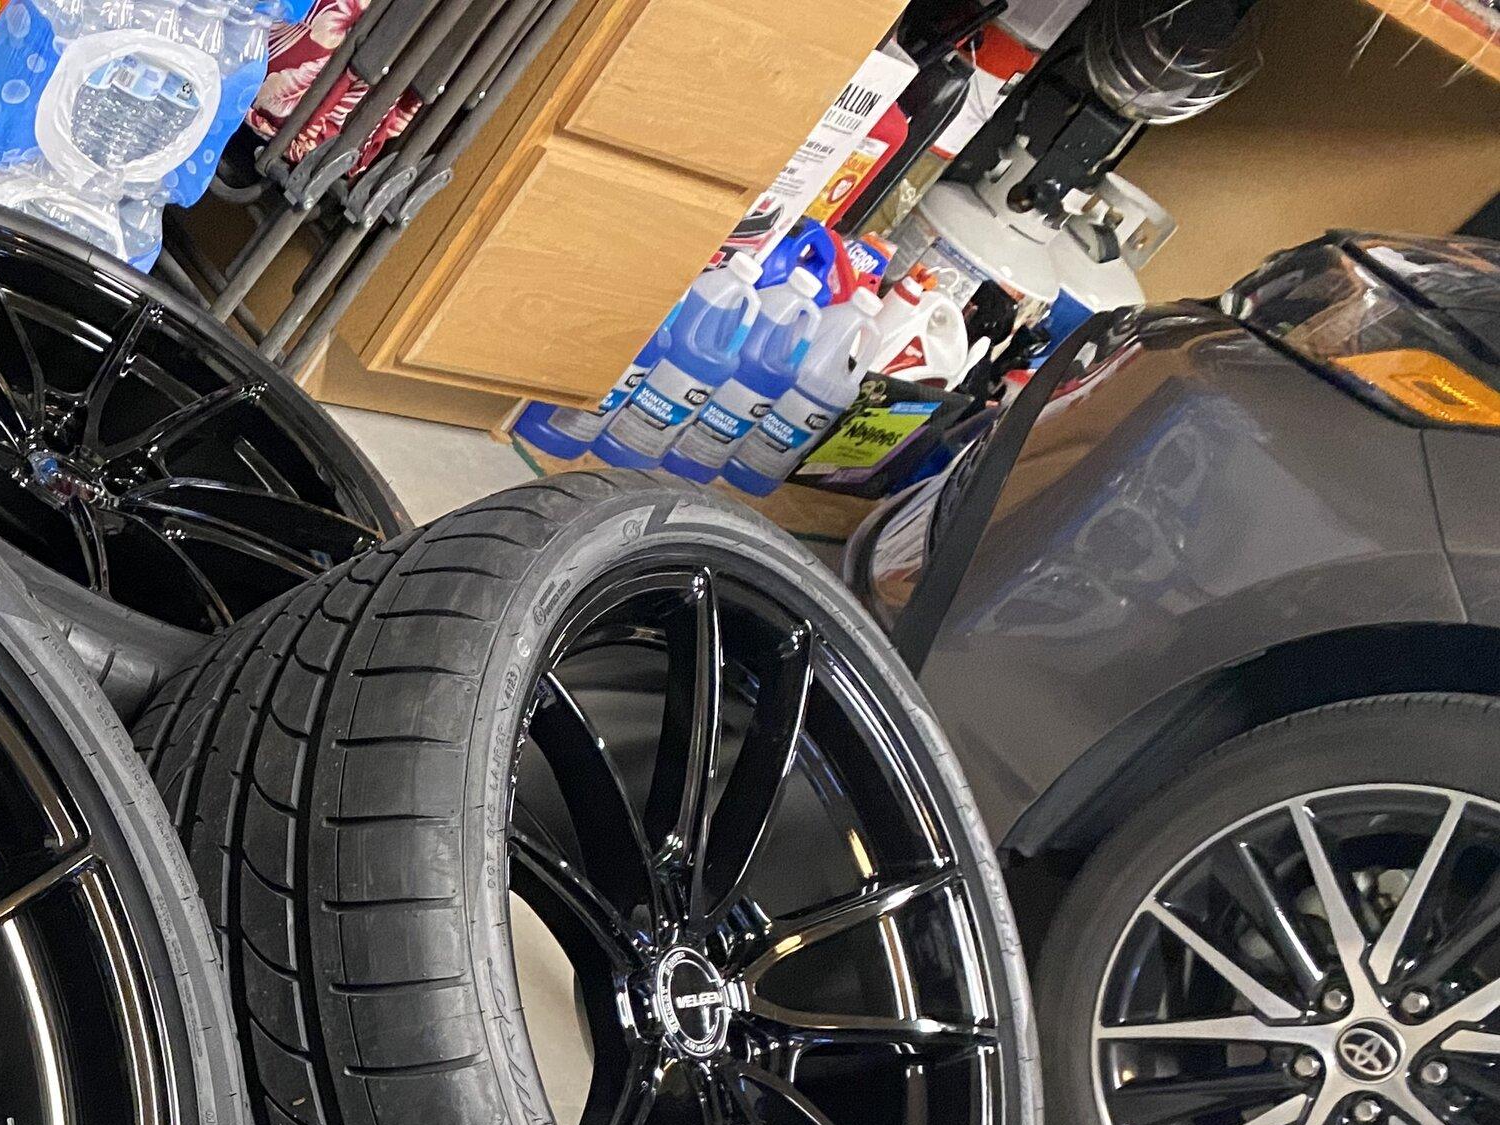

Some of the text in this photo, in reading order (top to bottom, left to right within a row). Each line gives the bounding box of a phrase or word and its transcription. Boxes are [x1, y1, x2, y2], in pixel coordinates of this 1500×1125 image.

[835, 83, 882, 117] ALLON
[636, 394, 674, 421] FORMULA
[642, 387, 674, 412] WINTER
[703, 411, 739, 435] FORMULA
[708, 404, 739, 426] WINTER
